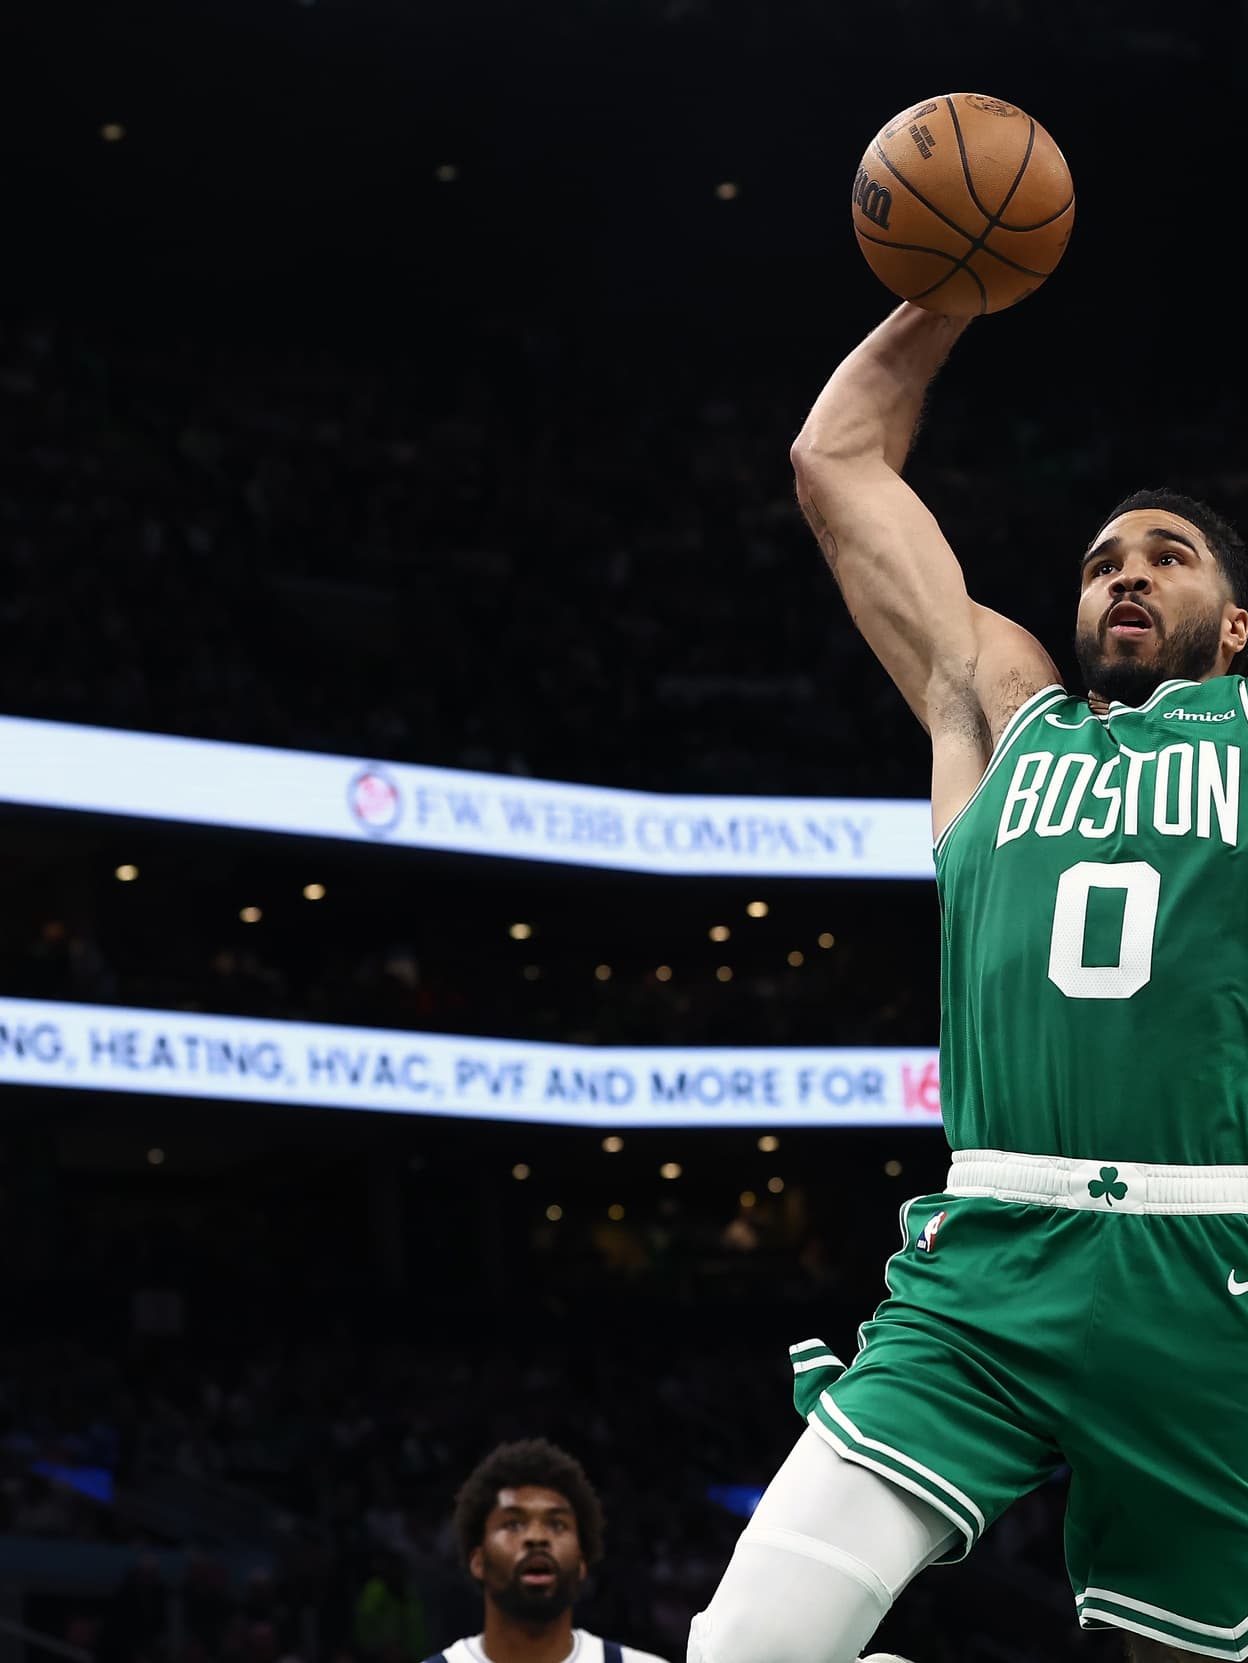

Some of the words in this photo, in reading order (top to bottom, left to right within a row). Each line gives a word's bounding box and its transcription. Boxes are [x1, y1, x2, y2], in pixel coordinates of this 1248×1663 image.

[1163, 708, 1235, 722] Amica
[499, 795, 626, 848] WEBB
[634, 809, 873, 858] COMPANY
[996, 740, 1241, 850] BOSTON
[1048, 861, 1161, 999] 0
[89, 1027, 296, 1085] HEATING,
[306, 1048, 445, 1097] HVAC,
[454, 1057, 527, 1097] PVF
[545, 1066, 636, 1106] AND
[650, 1068, 780, 1107] MORE
[797, 1067, 886, 1107] FOR
